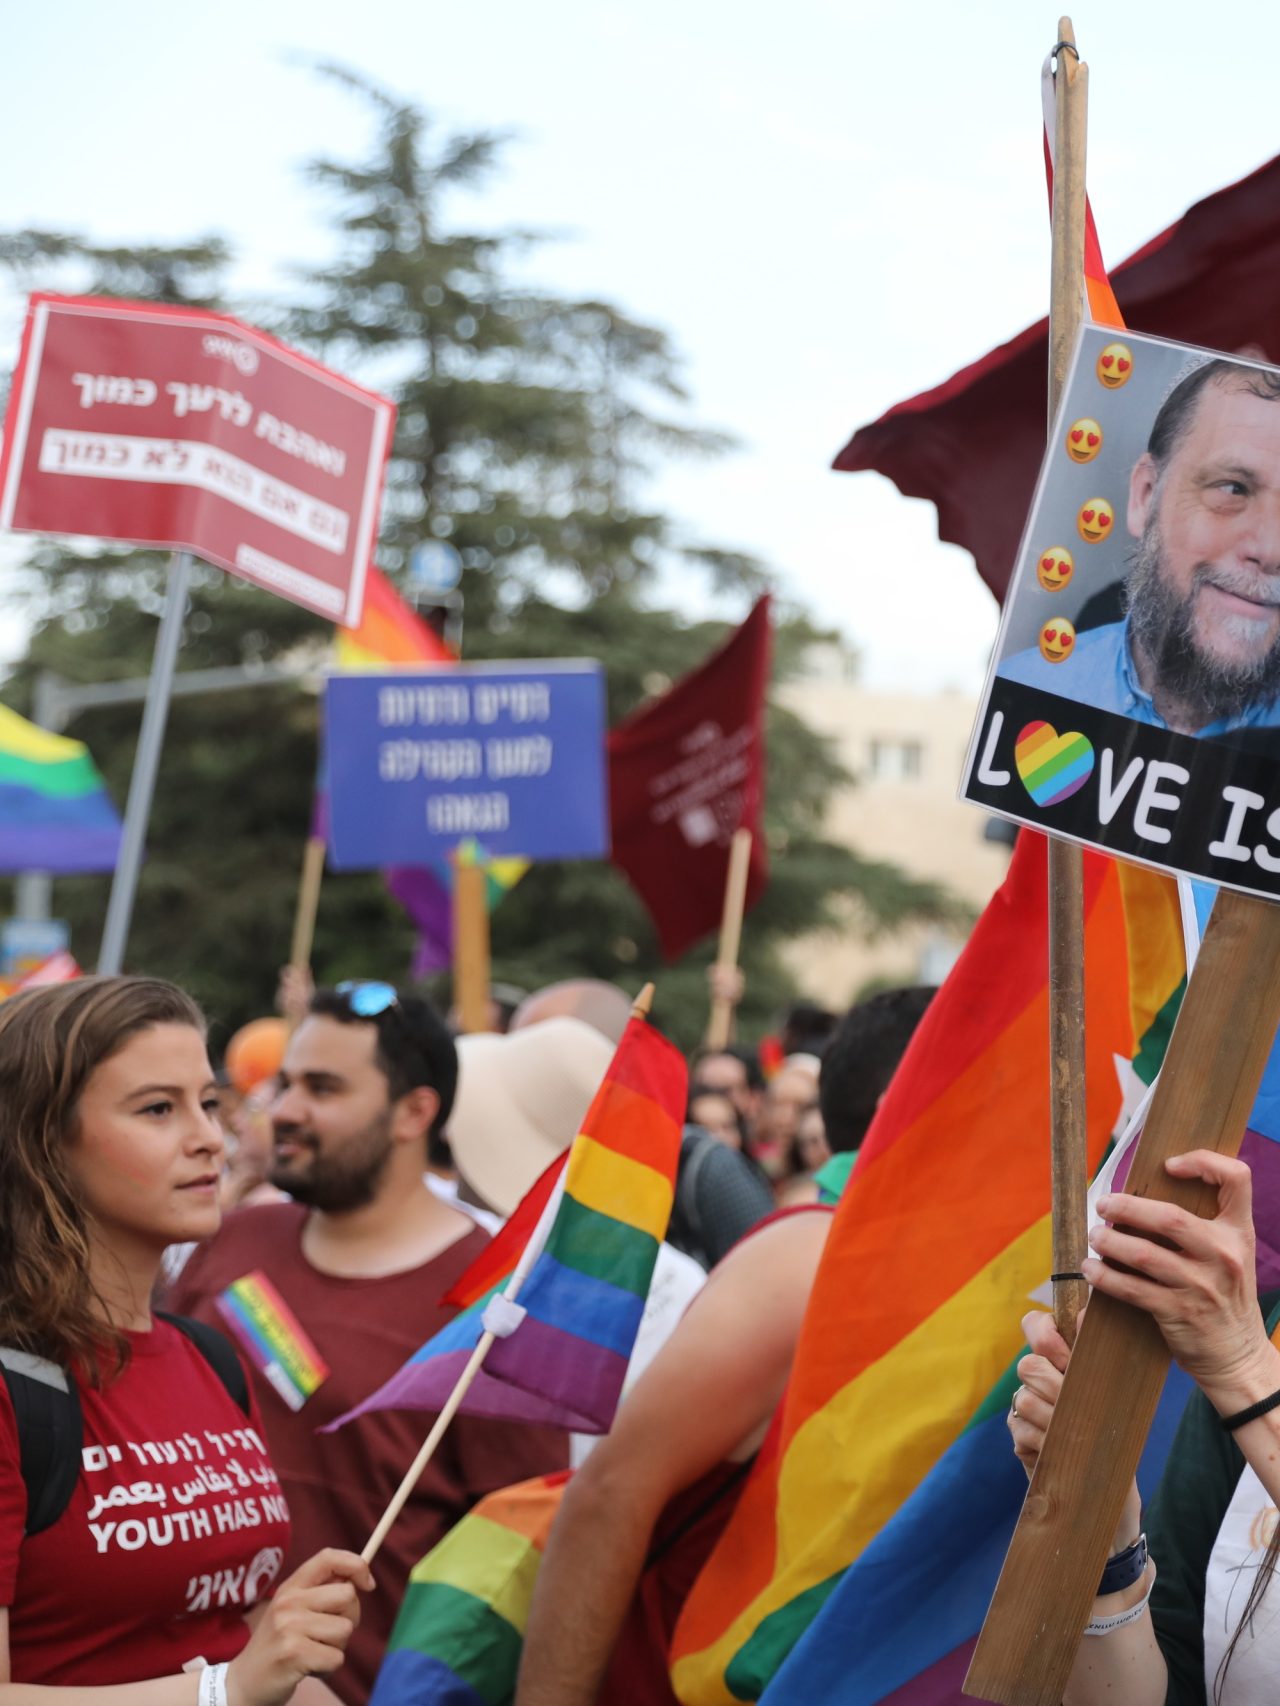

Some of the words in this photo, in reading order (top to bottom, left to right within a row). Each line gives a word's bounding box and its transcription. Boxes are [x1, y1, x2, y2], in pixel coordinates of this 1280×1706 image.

[71, 371, 157, 409] כמוך
[165, 380, 254, 427] לרעך
[88, 1507, 213, 1554] YOUTH
[212, 1498, 262, 1535] HAS
